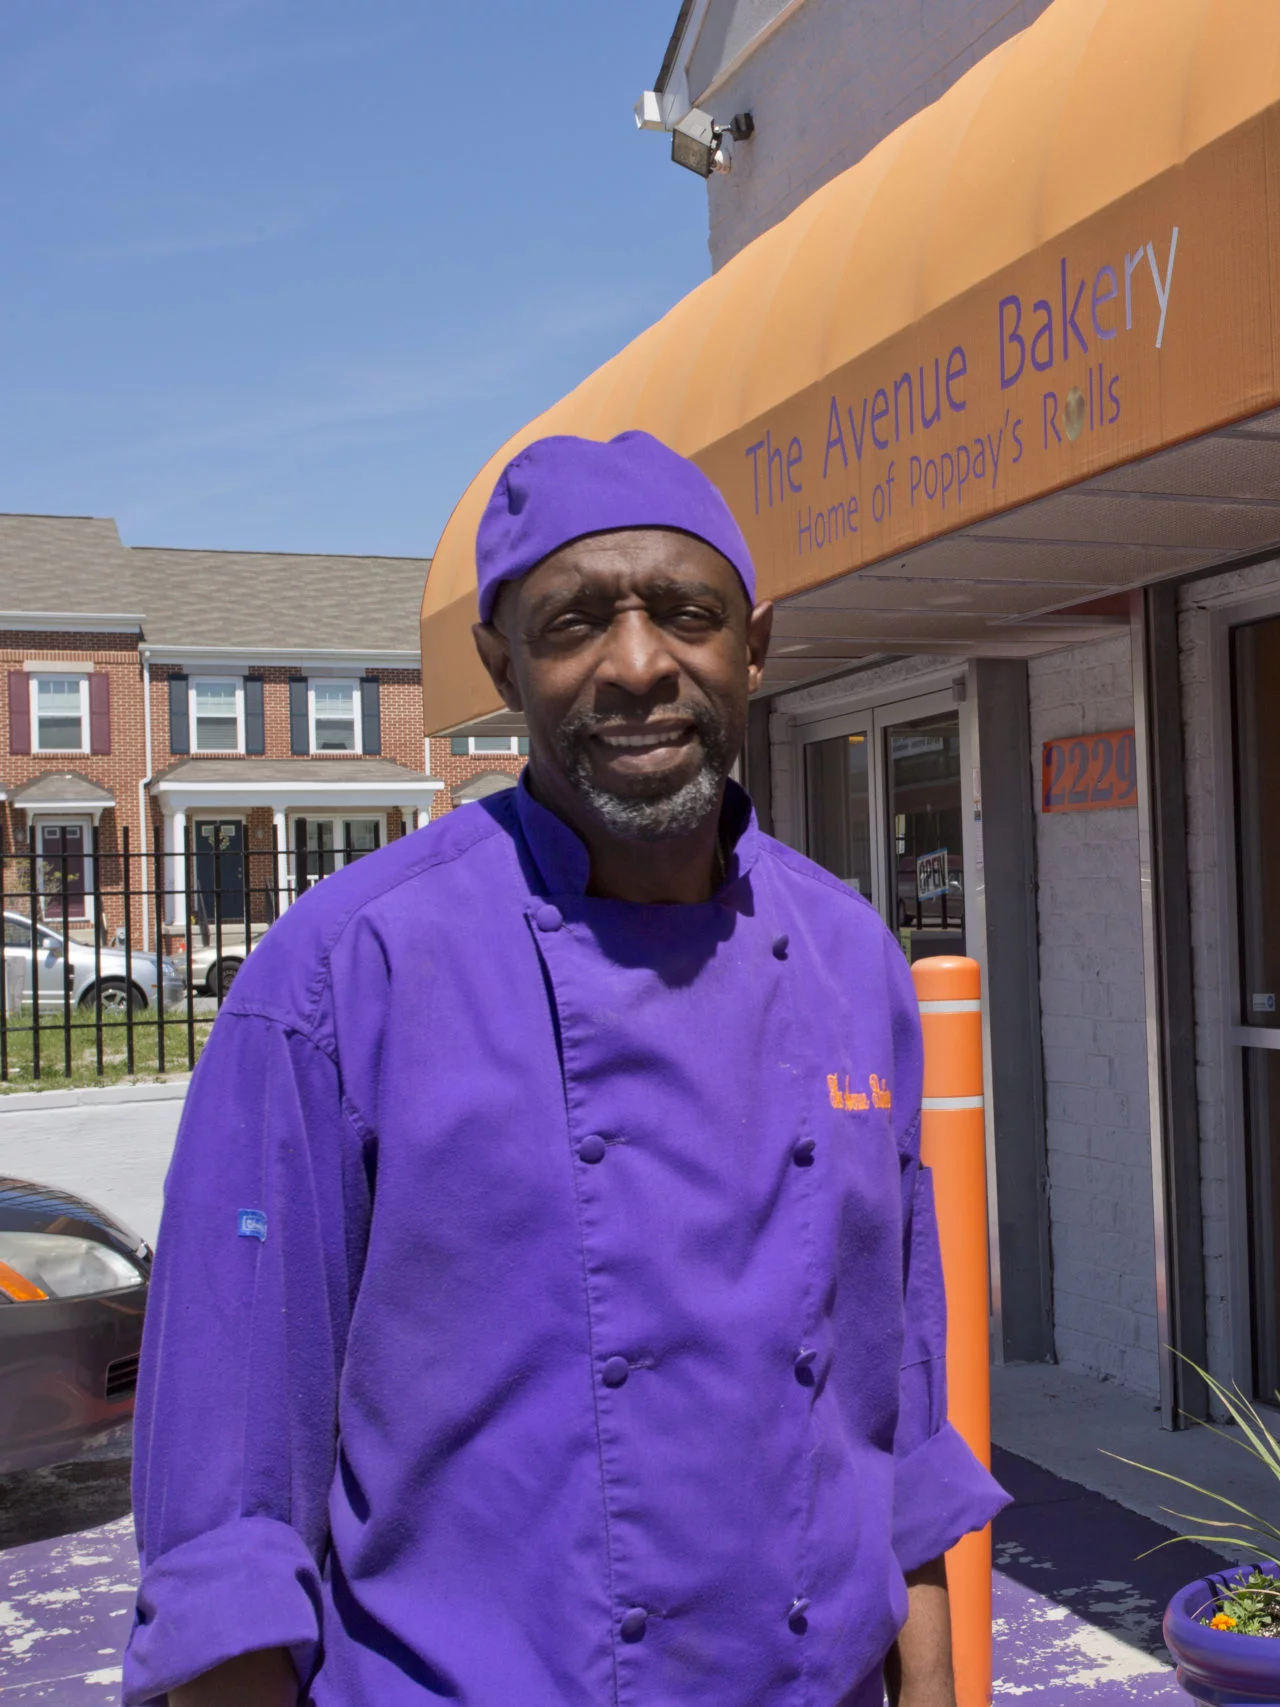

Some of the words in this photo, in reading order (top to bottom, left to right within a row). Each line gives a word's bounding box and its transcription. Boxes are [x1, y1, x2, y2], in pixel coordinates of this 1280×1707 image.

[745, 430, 803, 515] The
[822, 346, 967, 480] Avenue
[999, 226, 1179, 389] Bakery
[798, 496, 858, 556] Home
[872, 461, 895, 522] of
[909, 408, 1023, 510] Poppay's
[1045, 734, 1137, 807] 2229
[919, 853, 946, 894] OPEN
